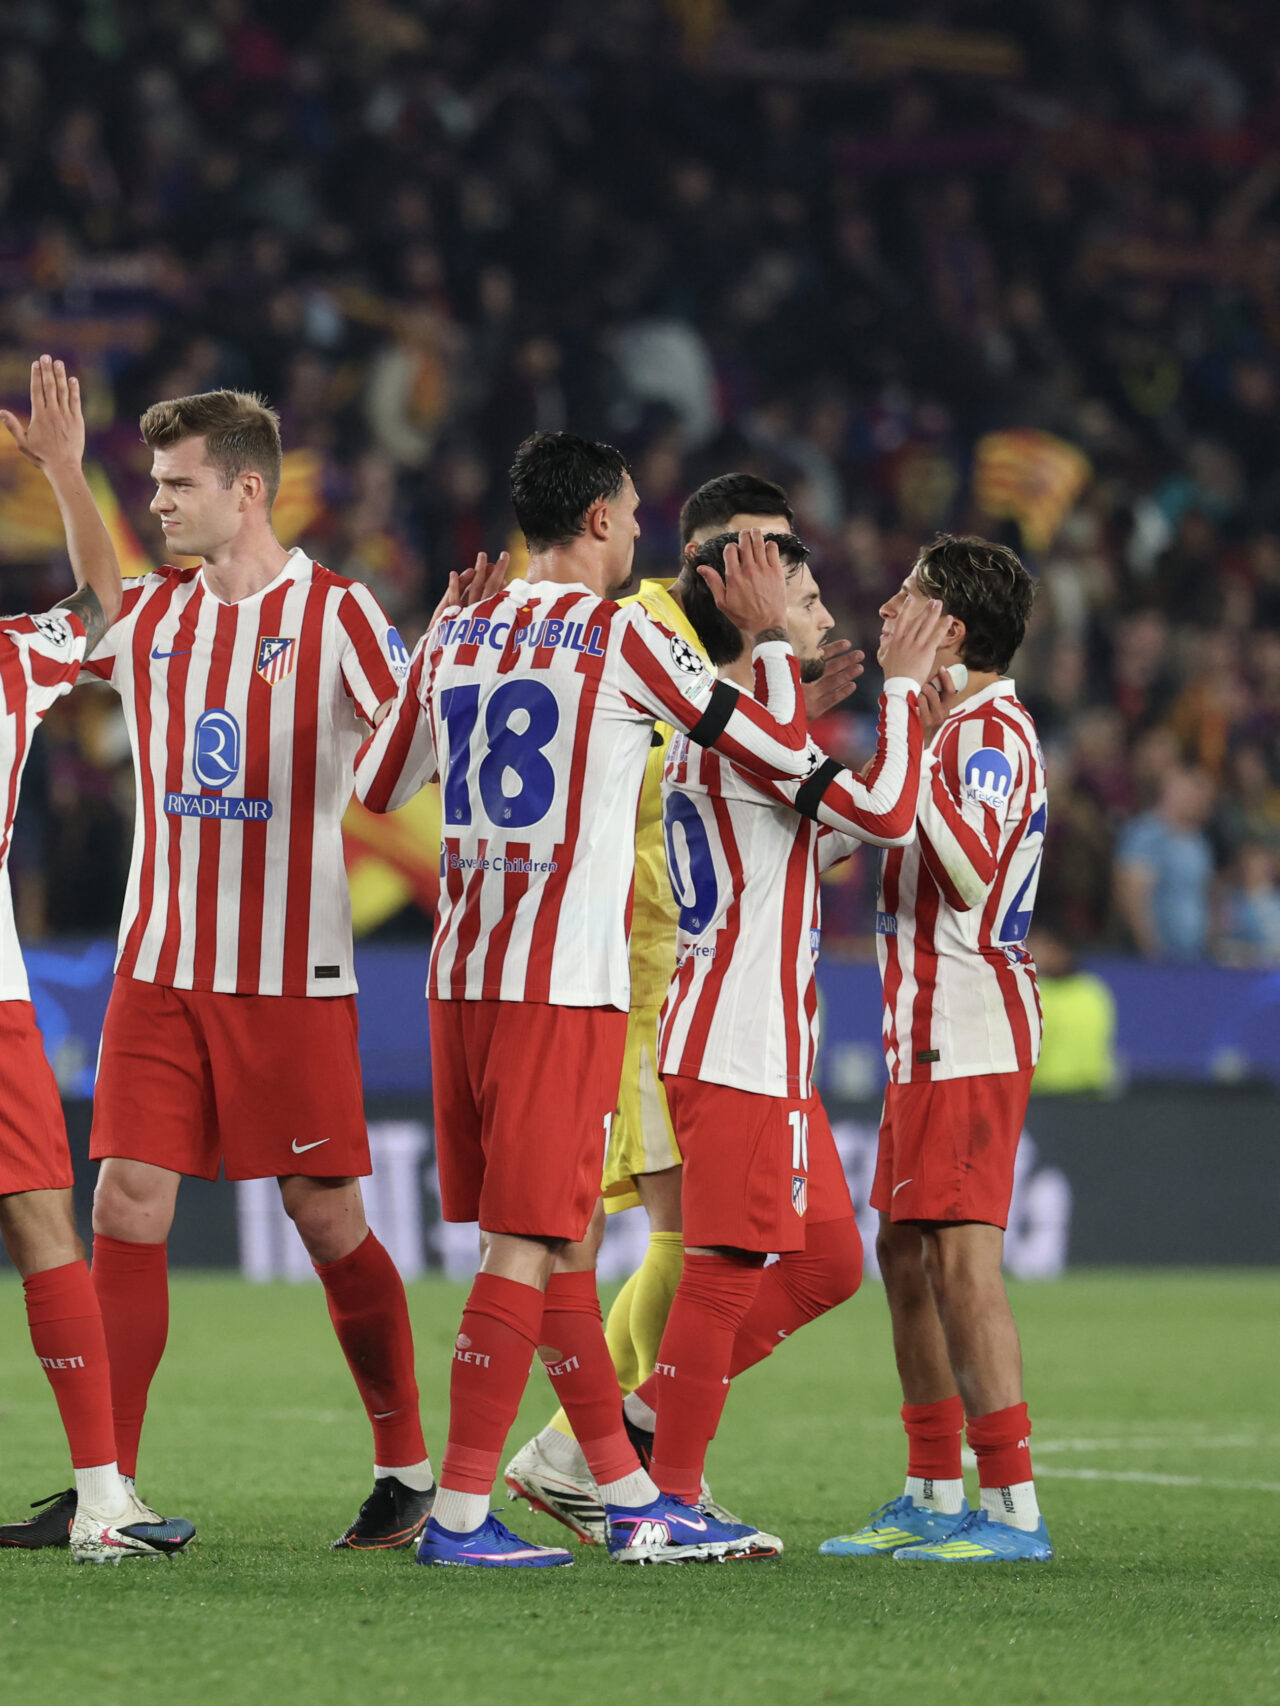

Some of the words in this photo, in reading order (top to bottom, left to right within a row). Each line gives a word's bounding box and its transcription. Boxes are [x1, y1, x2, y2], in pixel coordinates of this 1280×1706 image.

[514, 618, 605, 658] PUBILL
[440, 678, 560, 829] 18
[167, 794, 230, 818] RIYADH
[233, 801, 269, 819] AIR
[492, 857, 558, 873] Children
